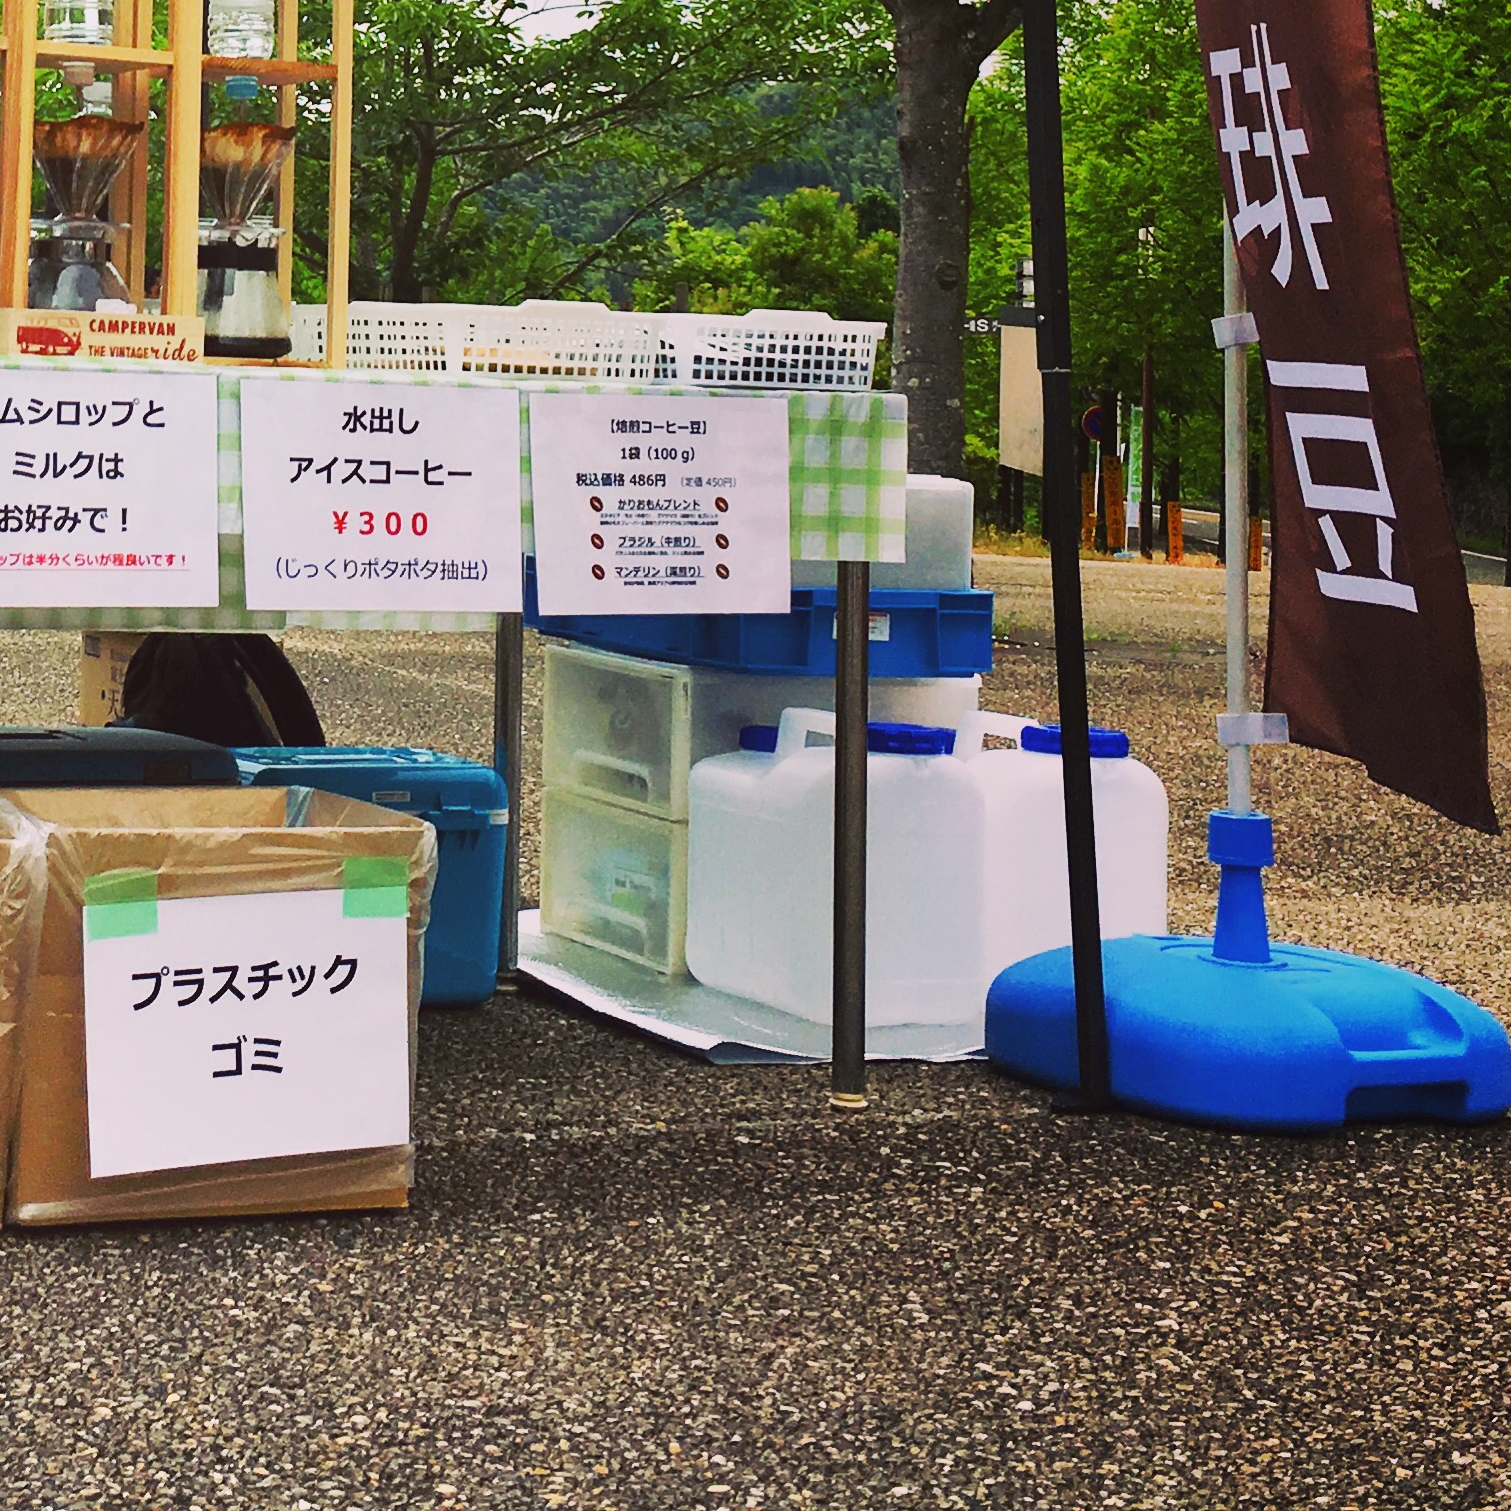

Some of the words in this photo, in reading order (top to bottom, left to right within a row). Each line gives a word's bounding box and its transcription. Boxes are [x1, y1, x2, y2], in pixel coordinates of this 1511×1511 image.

[89, 318, 176, 336] CAMPERVAN
[88, 345, 105, 357] THE
[109, 346, 149, 359] VINTAGE
[150, 337, 199, 362] ride
[341, 405, 420, 435] 水出し
[12, 450, 125, 480] ミルクは
[289, 456, 473, 486] アイスコーヒー
[332, 510, 428, 537] ¥300
[275, 556, 488, 582] （じっくりポタポタ抽出）
[131, 954, 358, 1012] プラスチック
[211, 1034, 284, 1079] ゴミ
